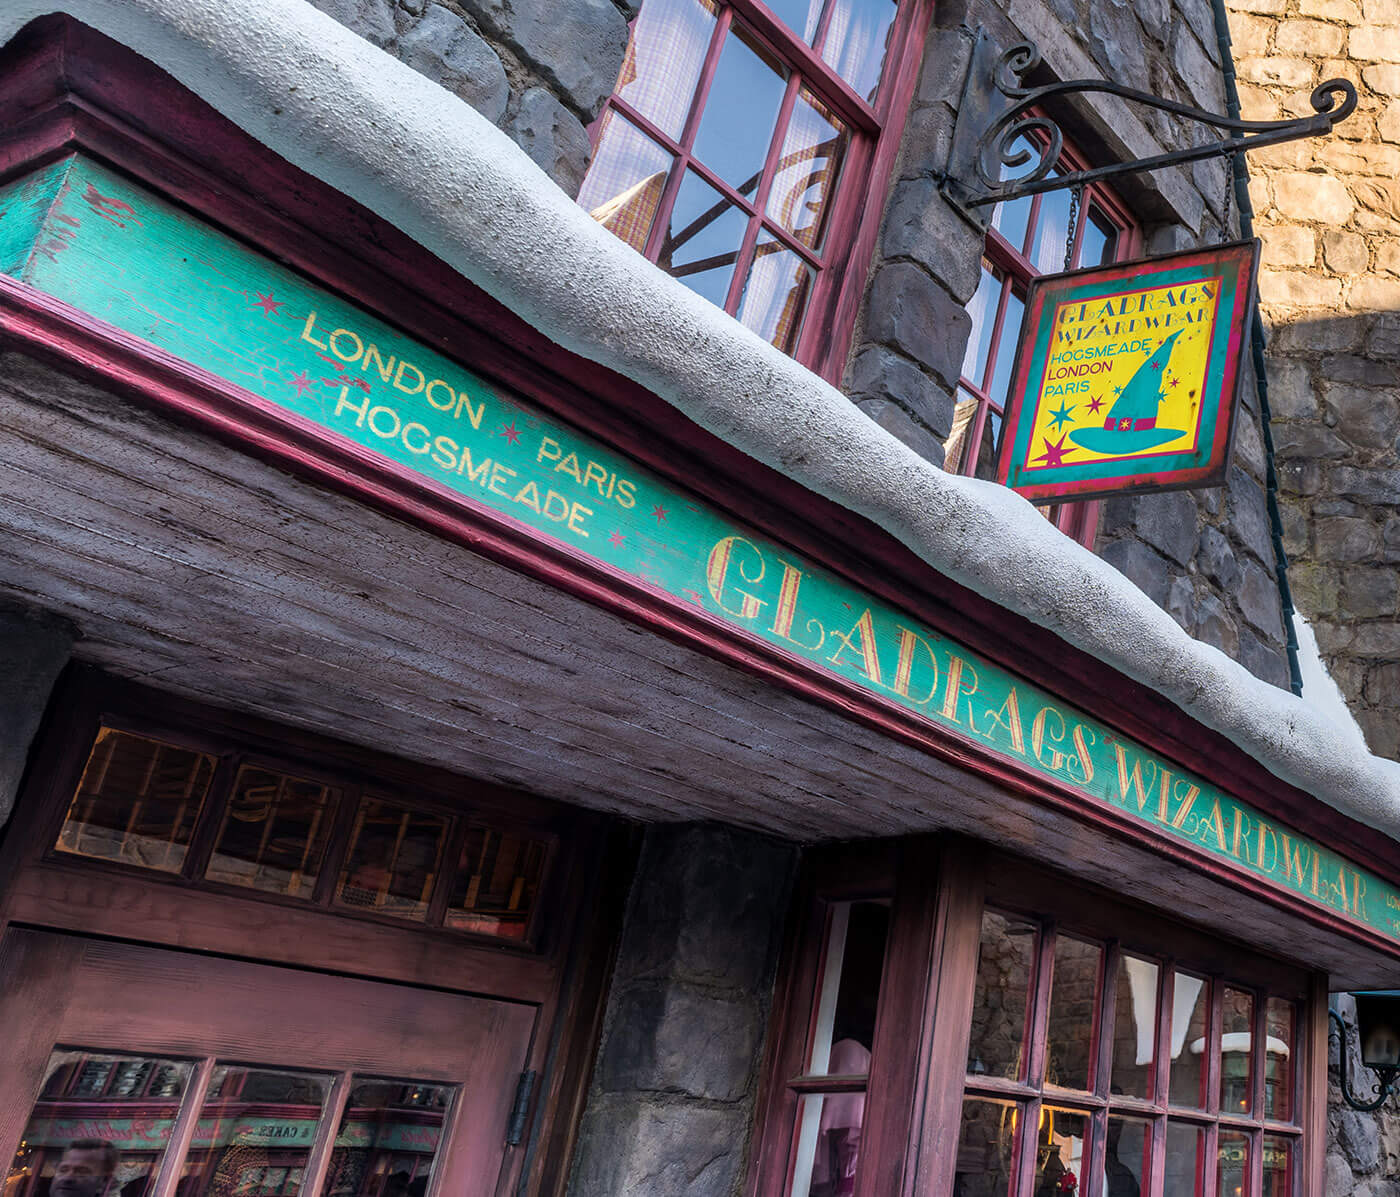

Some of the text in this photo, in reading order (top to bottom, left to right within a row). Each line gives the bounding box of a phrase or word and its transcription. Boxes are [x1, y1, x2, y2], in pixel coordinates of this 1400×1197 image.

[1058, 283, 1215, 325] GLADRAGS
[1057, 308, 1209, 344] WIZARDWEAR
[1047, 360, 1113, 381] LONDON
[1050, 338, 1153, 364] HOGSMEADE
[1044, 380, 1090, 398] PARIS
[301, 310, 639, 509] LONDON PARIS
[334, 386, 594, 538] HOGSMEADE
[706, 536, 1369, 922] GLADRAGS WIZARDWEAR
